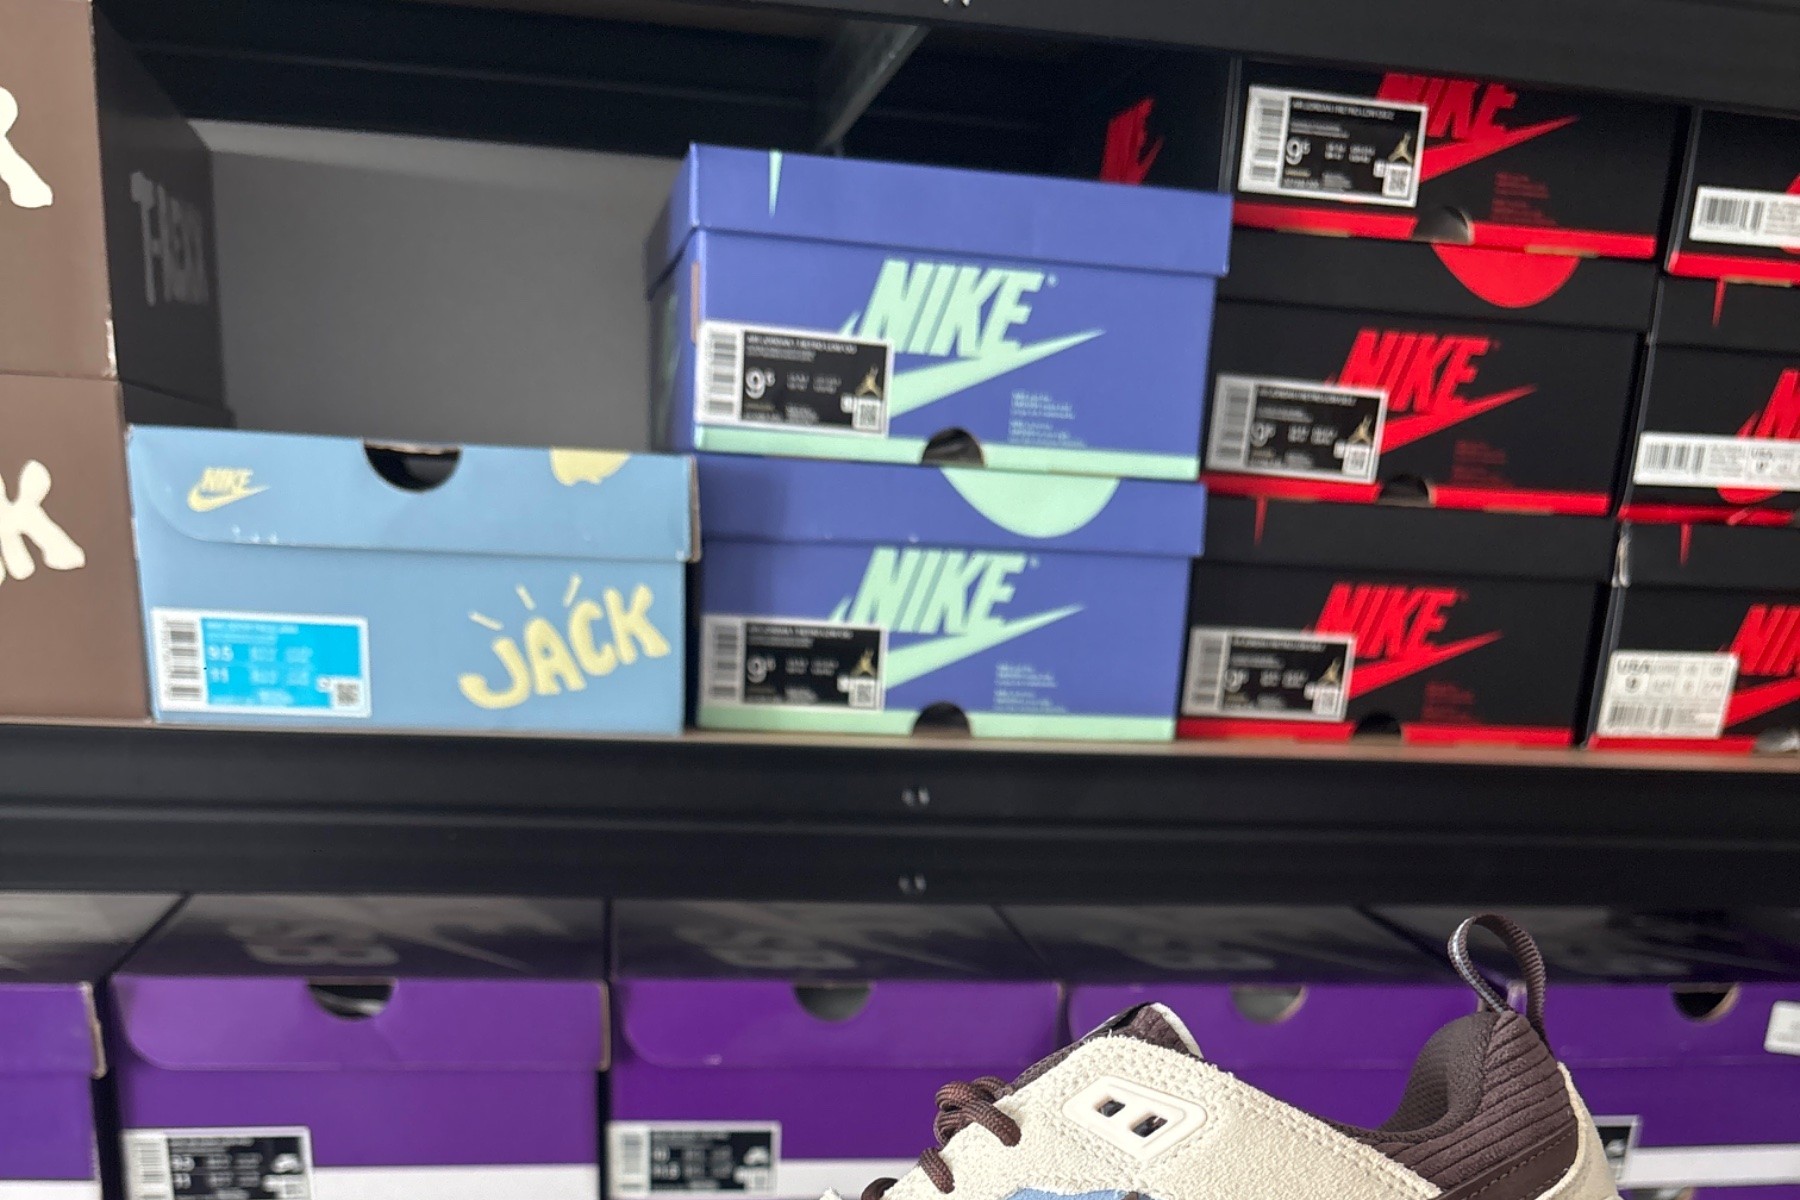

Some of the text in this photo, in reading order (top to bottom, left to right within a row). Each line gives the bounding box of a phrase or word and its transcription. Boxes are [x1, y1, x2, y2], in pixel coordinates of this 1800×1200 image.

[857, 258, 1046, 359] NIKE
[1336, 328, 1490, 414] NIKE
[850, 546, 1028, 638] NIKE
[1314, 582, 1458, 661] NIKE
[457, 583, 672, 711] JACK
